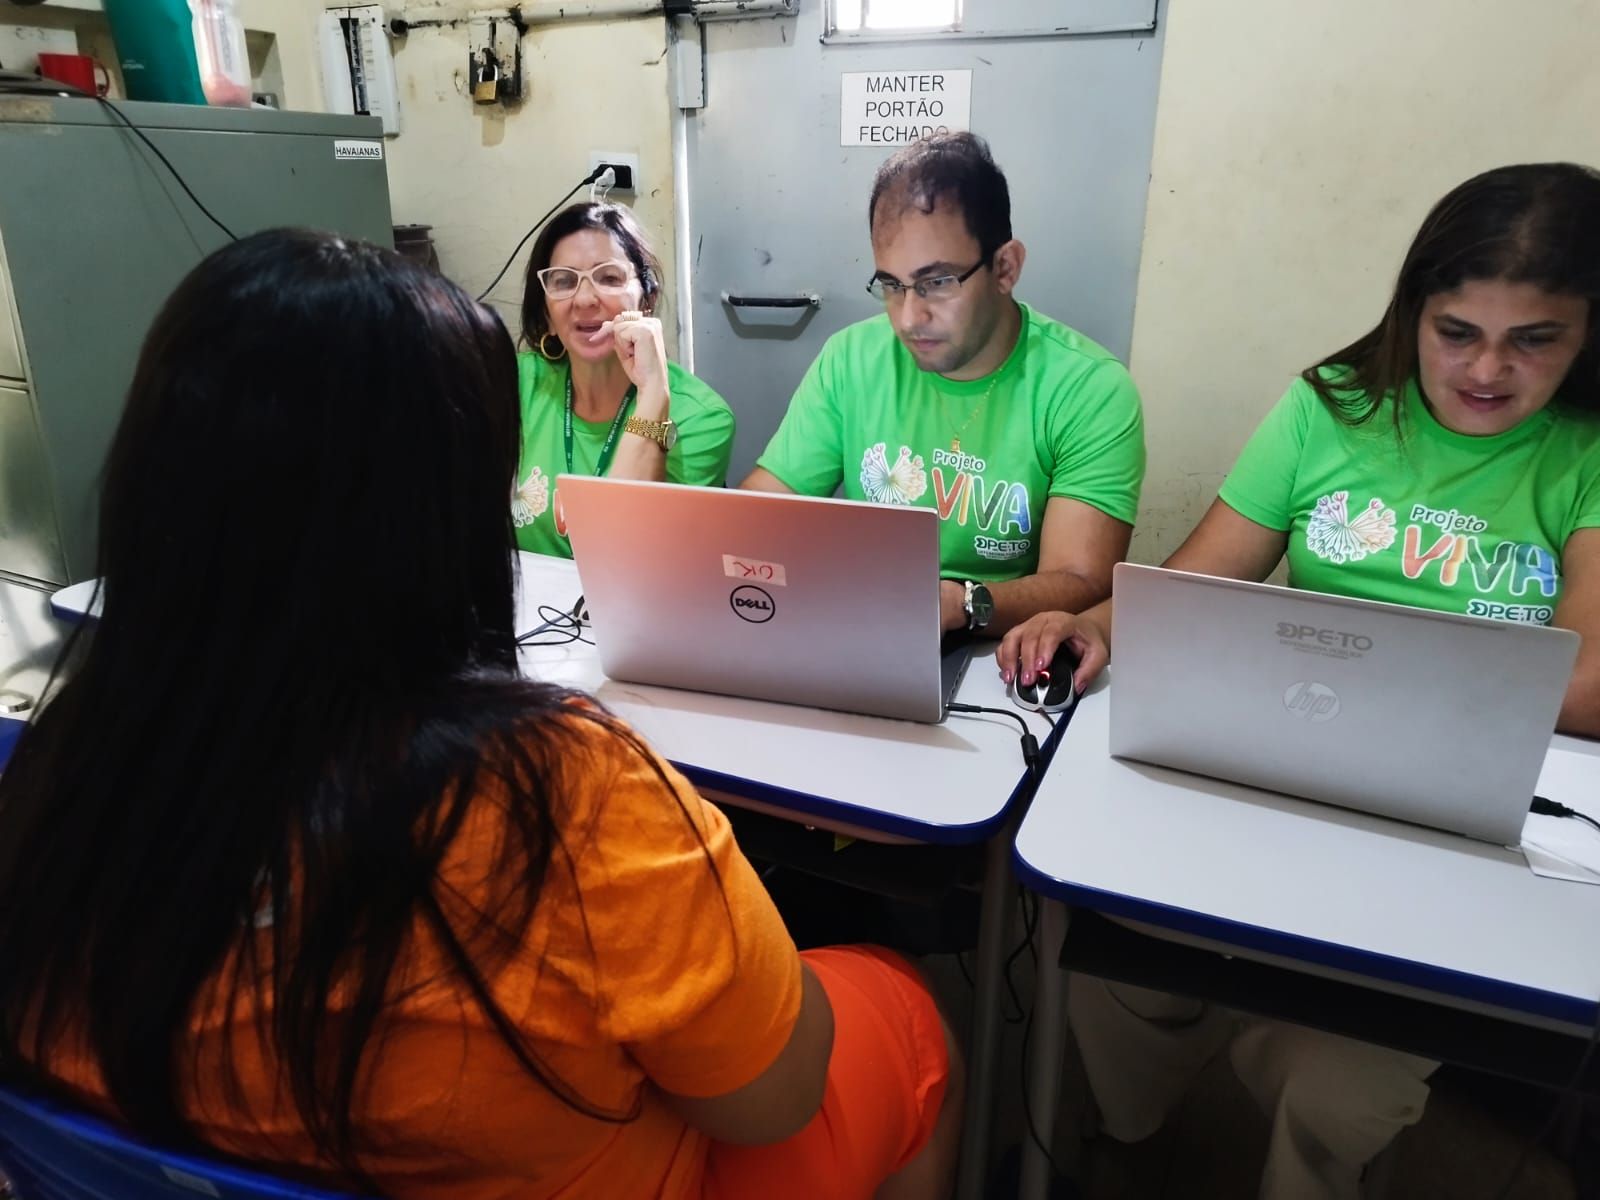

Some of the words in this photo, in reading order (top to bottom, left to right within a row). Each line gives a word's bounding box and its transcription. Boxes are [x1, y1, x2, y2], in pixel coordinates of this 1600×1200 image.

[866, 75, 945, 93] MANTER
[866, 98, 944, 118] PORTÃO
[335, 146, 380, 156] HAVAIANAS
[934, 450, 984, 471] Projeto
[931, 467, 1031, 535] VIVA
[1411, 506, 1486, 531] Projeto
[1402, 525, 1557, 597] VIVA
[735, 598, 771, 611] DELL
[1287, 680, 1338, 721] hp
